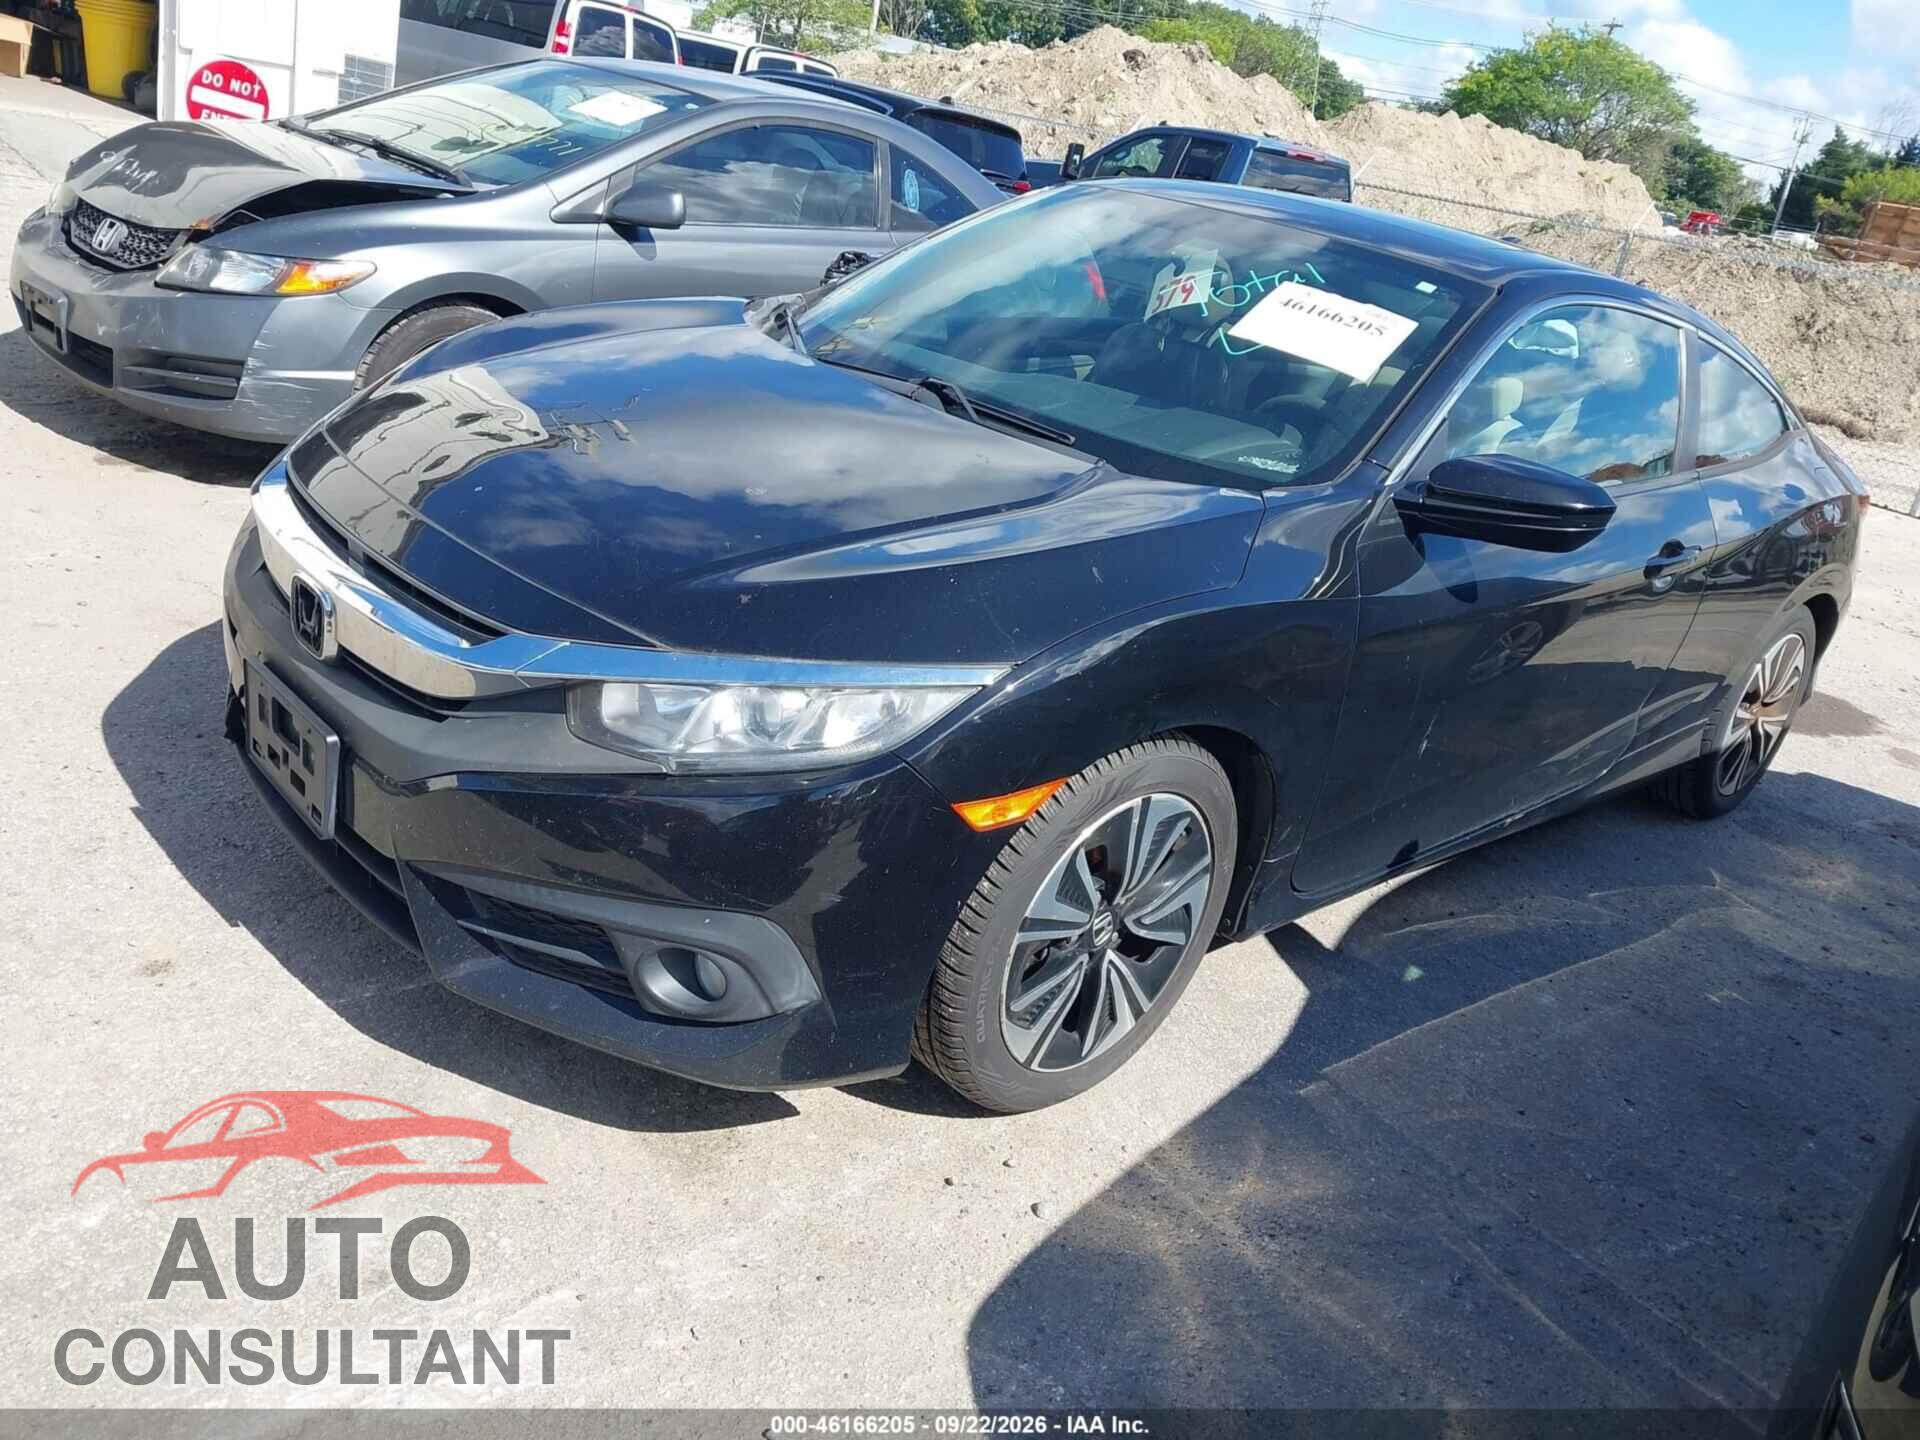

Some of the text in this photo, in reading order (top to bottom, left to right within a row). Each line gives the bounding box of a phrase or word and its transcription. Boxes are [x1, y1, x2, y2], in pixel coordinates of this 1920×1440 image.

[201, 69, 261, 99] DO NOT
[1280, 297, 1389, 337] 46166205
